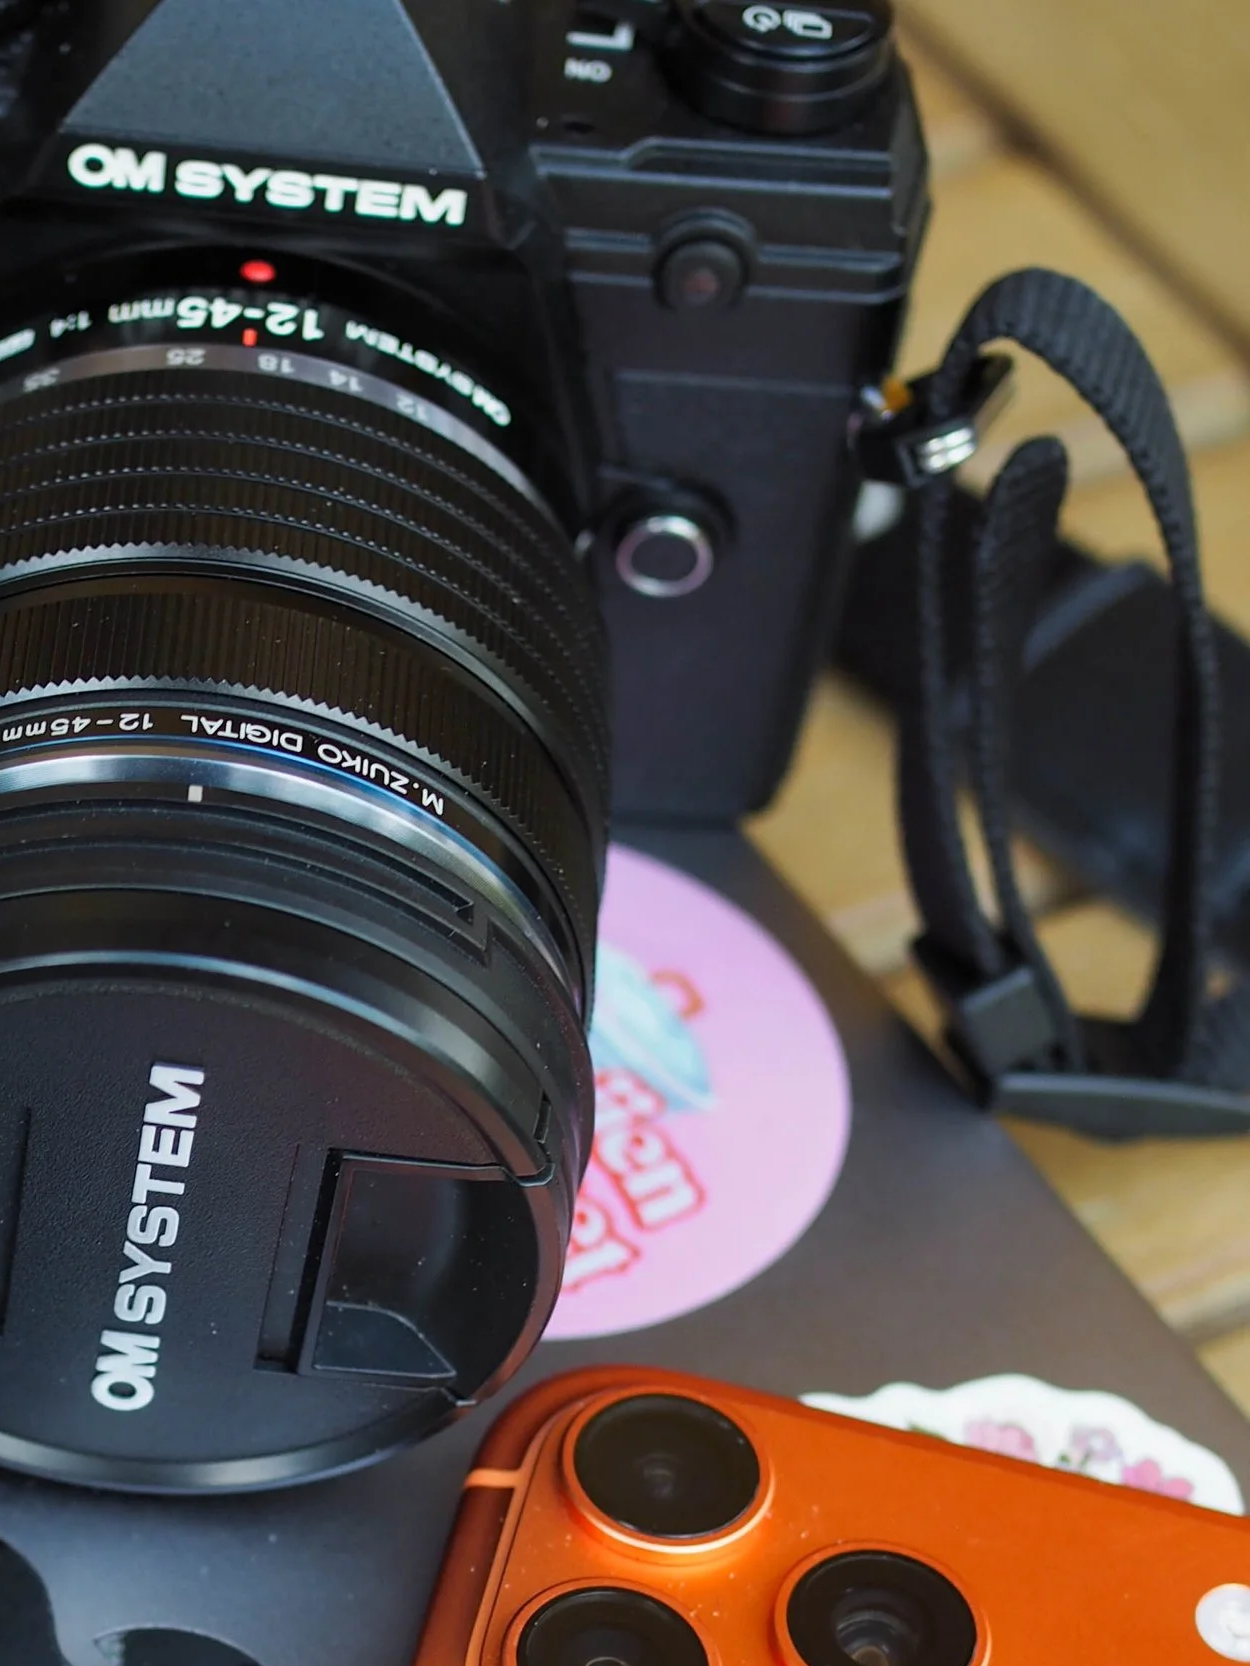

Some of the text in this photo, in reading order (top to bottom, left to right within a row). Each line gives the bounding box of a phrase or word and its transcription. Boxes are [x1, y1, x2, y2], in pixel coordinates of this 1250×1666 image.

[67, 143, 467, 225] OM SYSTEM
[50, 311, 92, 338] 1:4
[107, 296, 324, 340] 12-45mm
[166, 348, 206, 367] 25
[257, 353, 295, 374] 18
[329, 368, 365, 393] 14
[396, 393, 431, 421] 12
[2, 712, 154, 742] 12-45mm
[180, 713, 304, 753] DIGITAL
[316, 741, 445, 816] M.ZUIKO
[90, 1064, 206, 1412] OM SYSTEM
